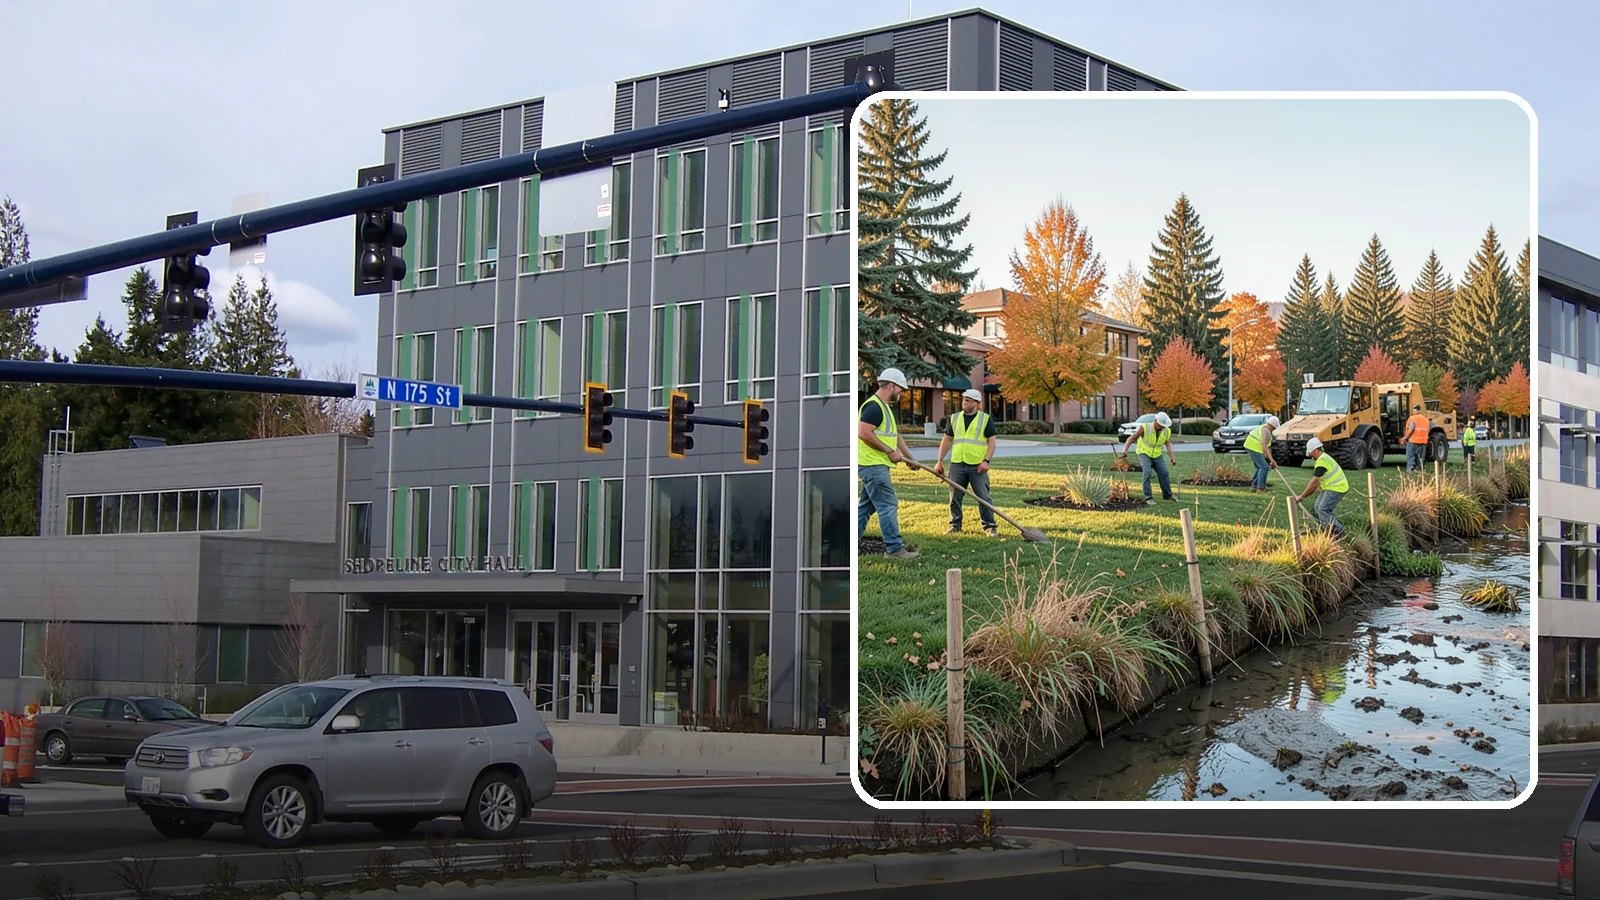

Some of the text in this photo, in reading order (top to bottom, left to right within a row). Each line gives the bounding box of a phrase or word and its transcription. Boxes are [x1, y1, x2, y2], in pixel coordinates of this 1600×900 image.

[387, 380, 451, 406] N 175 St
[344, 555, 525, 575] SHORELINE CITY HALL
